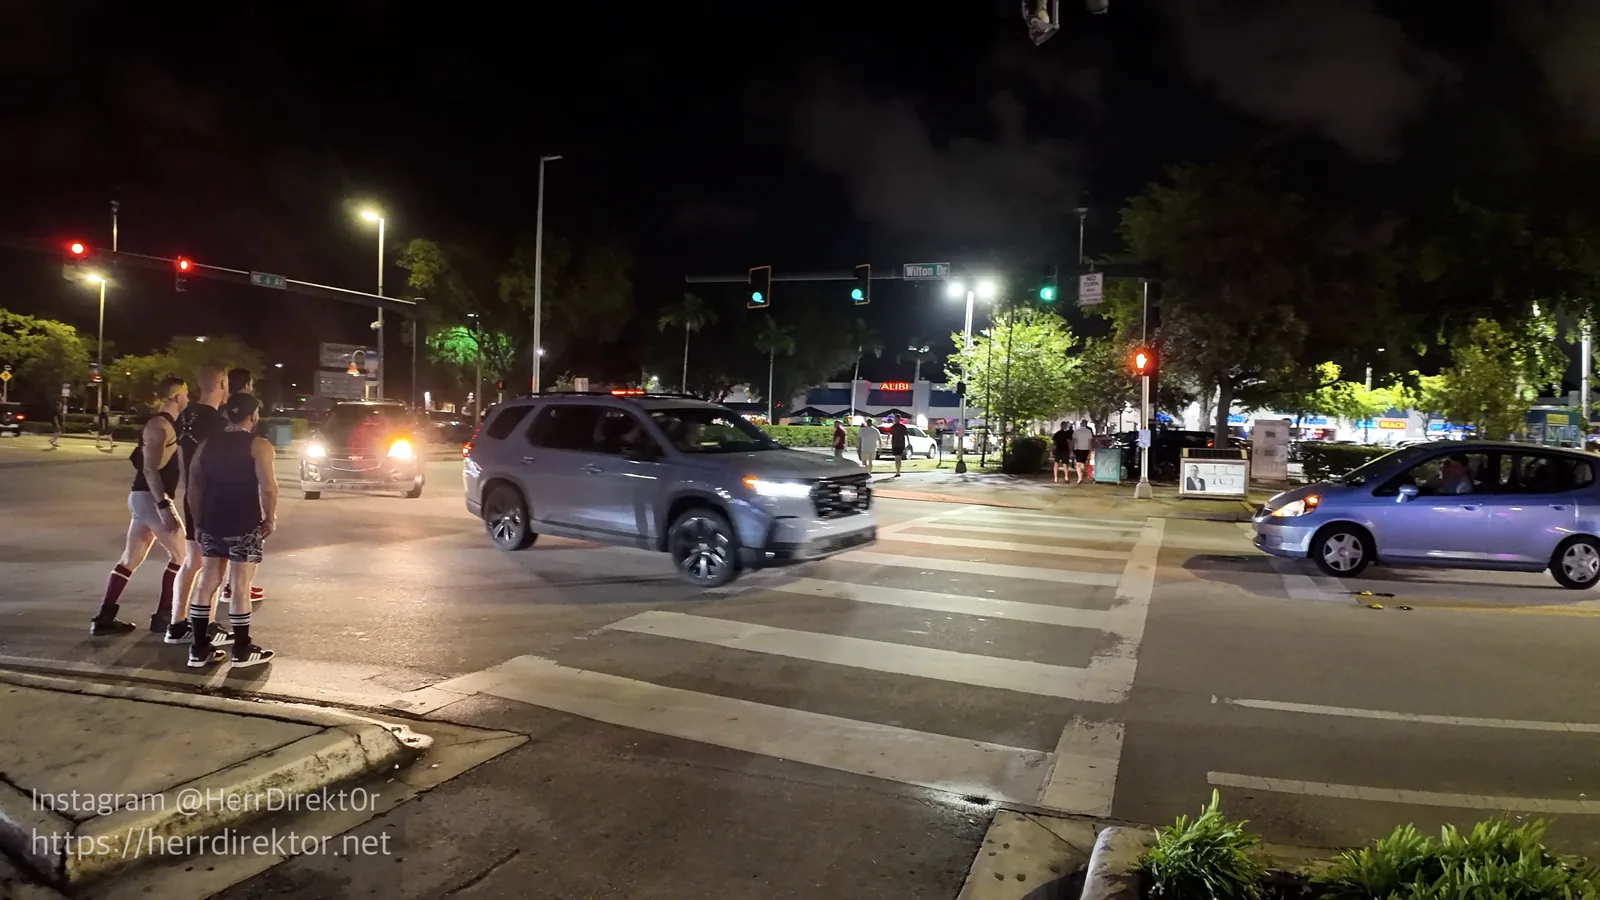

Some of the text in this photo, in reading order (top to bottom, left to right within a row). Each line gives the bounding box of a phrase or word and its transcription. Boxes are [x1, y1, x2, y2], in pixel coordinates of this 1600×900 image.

[906, 264, 948, 277] Wilton Dr
[1379, 421, 1406, 429] BEACH
